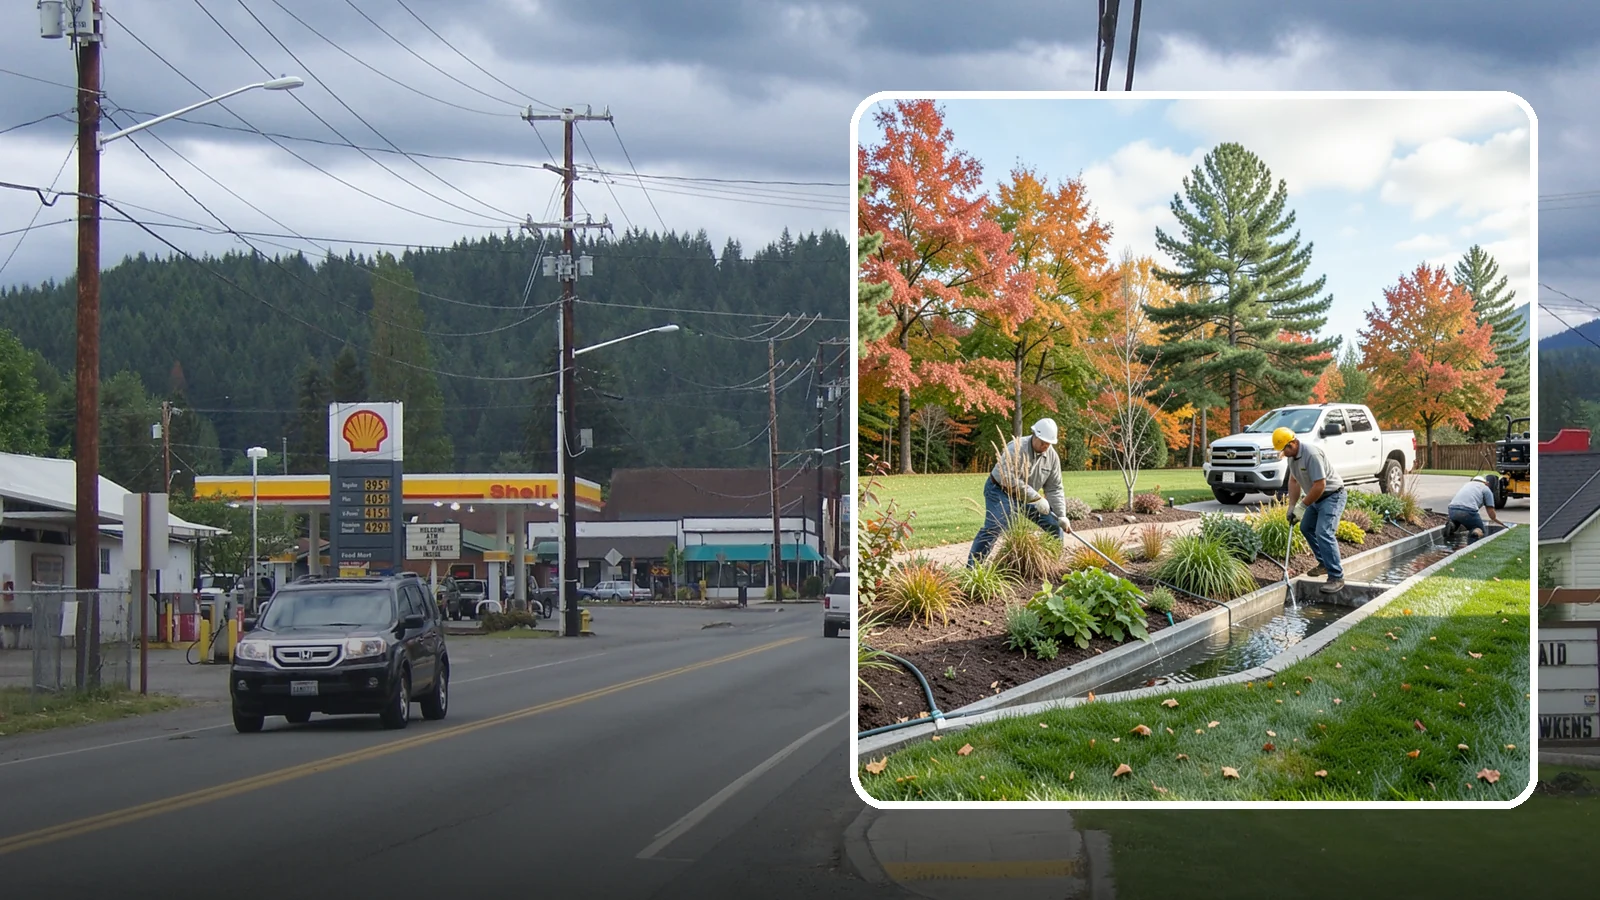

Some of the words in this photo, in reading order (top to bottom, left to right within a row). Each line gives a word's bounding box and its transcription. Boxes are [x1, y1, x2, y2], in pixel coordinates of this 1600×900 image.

[366, 480, 384, 490] 395
[490, 484, 547, 498] Shell
[366, 494, 384, 504] 405
[366, 508, 384, 518] 415
[366, 522, 384, 532] 429
